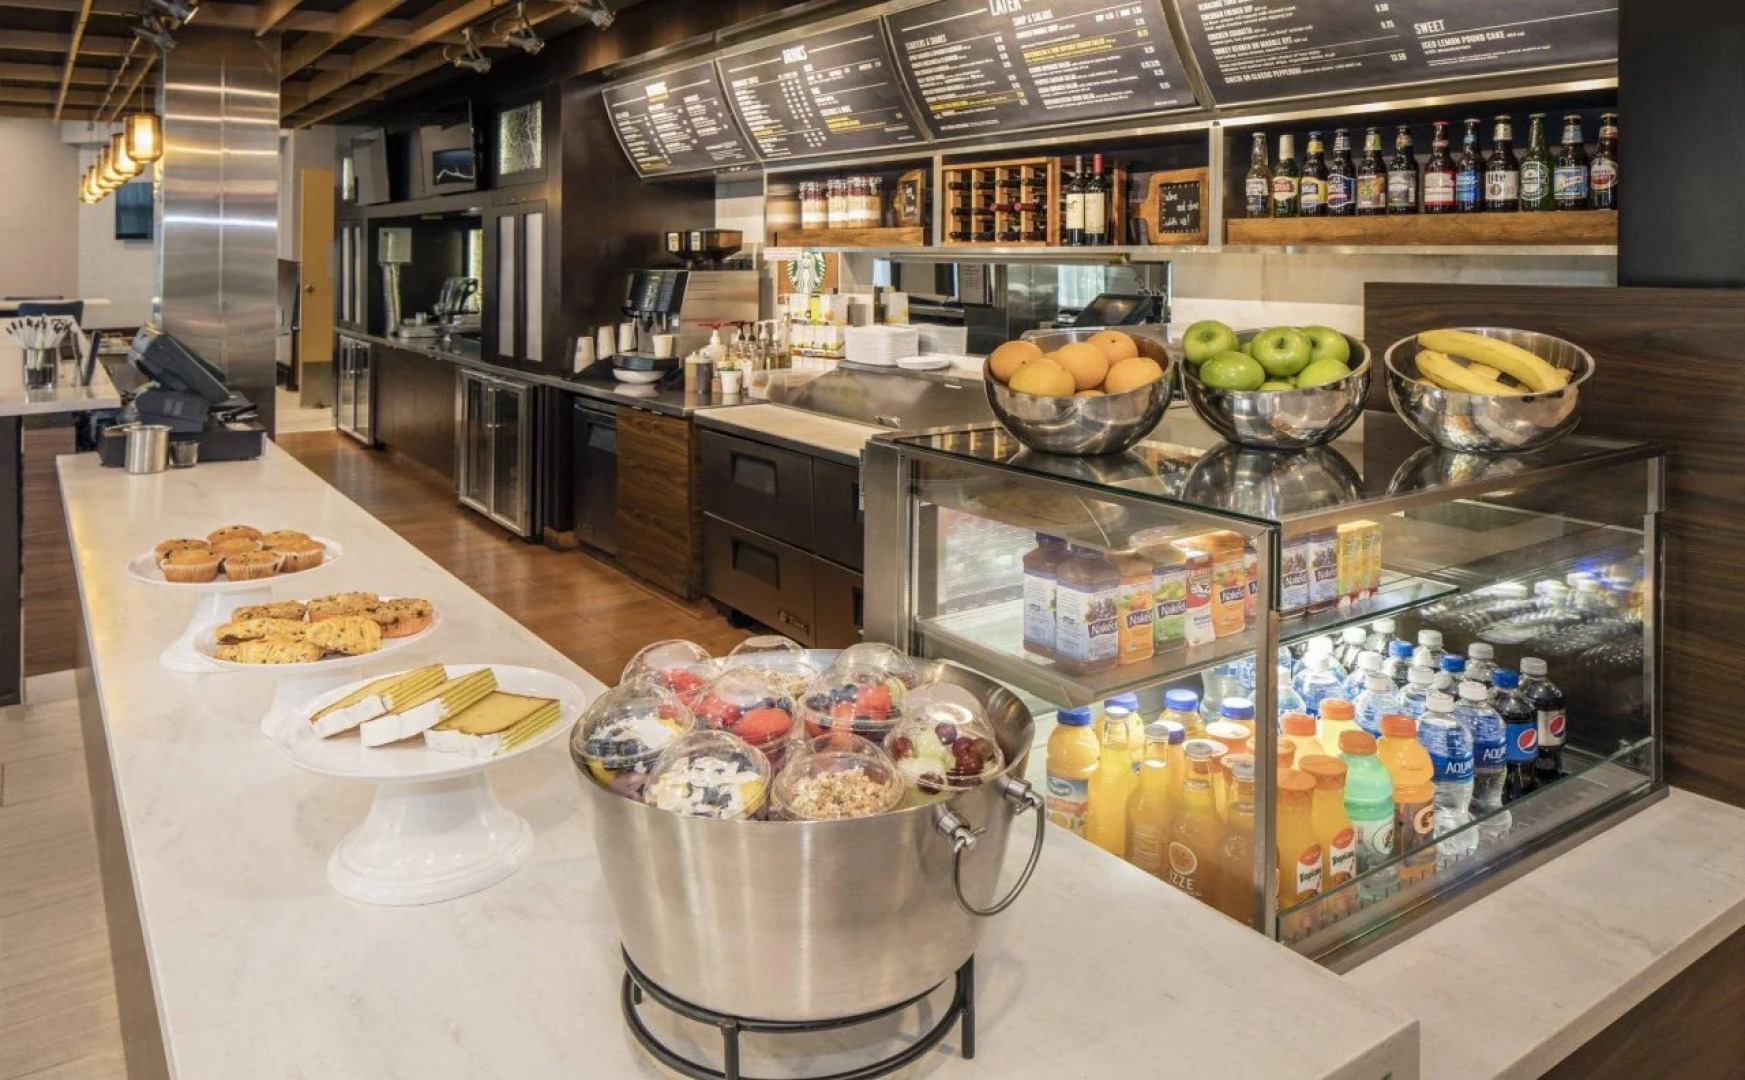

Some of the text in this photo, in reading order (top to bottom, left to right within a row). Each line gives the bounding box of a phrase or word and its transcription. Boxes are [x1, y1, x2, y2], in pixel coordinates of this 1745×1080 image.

[1414, 19, 1445, 34] SWEET
[1437, 37, 1461, 47] LEMON
[1461, 33, 1486, 44] POUND
[1486, 30, 1505, 41] CAKE
[1161, 601, 1186, 616] Naked
[1168, 868, 1195, 891] IZZE
